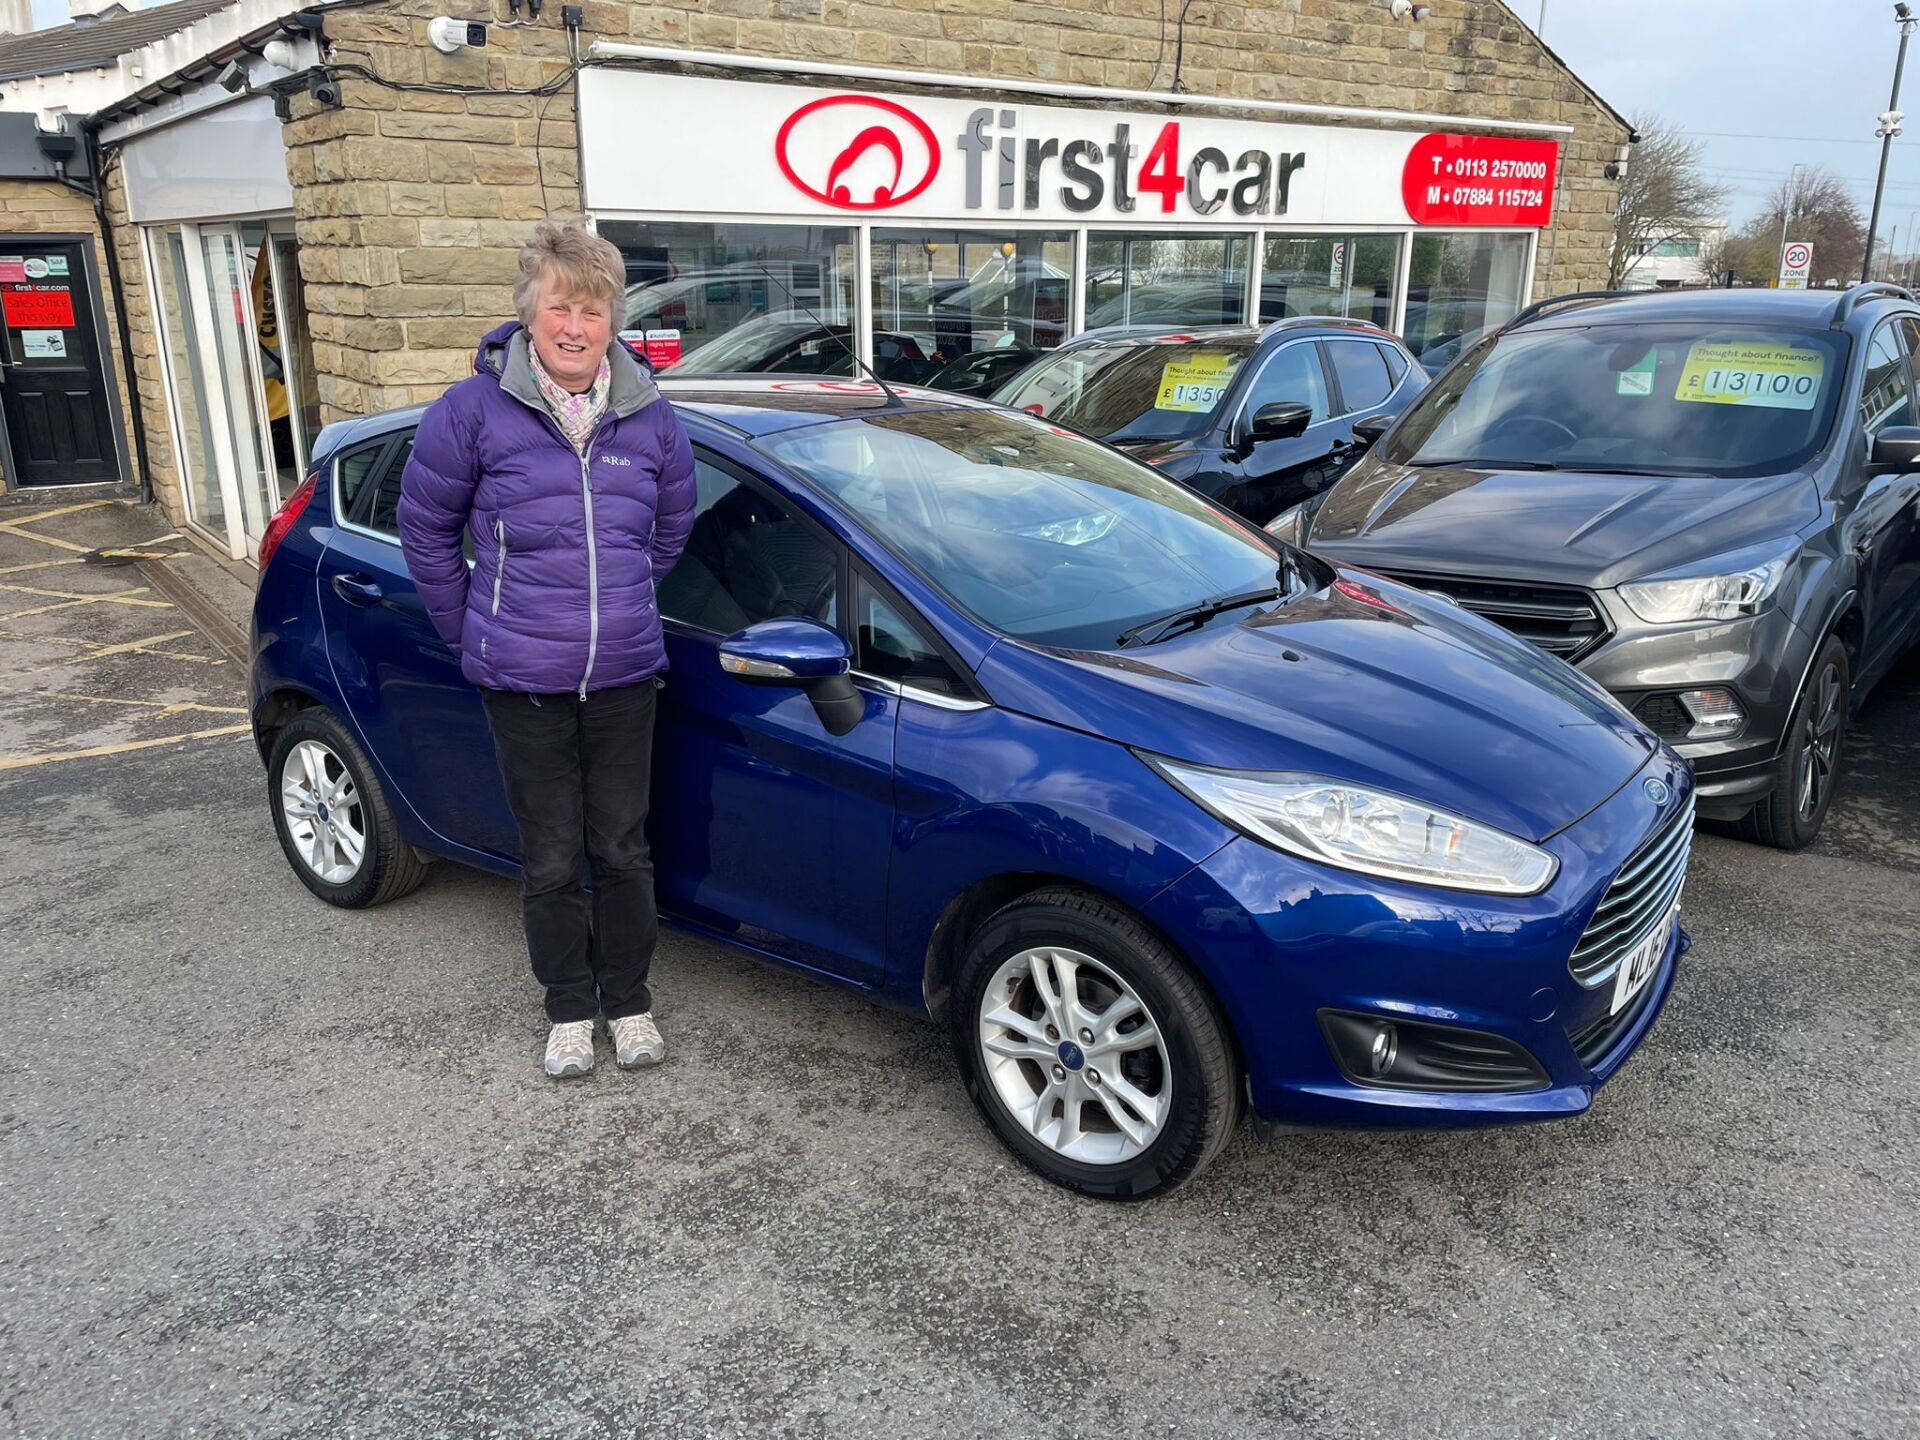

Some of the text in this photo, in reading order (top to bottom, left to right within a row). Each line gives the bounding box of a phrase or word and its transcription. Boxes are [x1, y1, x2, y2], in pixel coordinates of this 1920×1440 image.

[957, 107, 1305, 216] first4car
[1455, 158, 1487, 176] 0113
[1491, 160, 1546, 179] 2570000
[1453, 187, 1494, 205] 07884
[1498, 190, 1543, 206] 115724
[1789, 251, 1806, 262] 20
[1697, 347, 1820, 363] Thought about finance?
[1169, 366, 1196, 376] Thought
[1197, 368, 1217, 376] about
[611, 455, 631, 467] Rab
